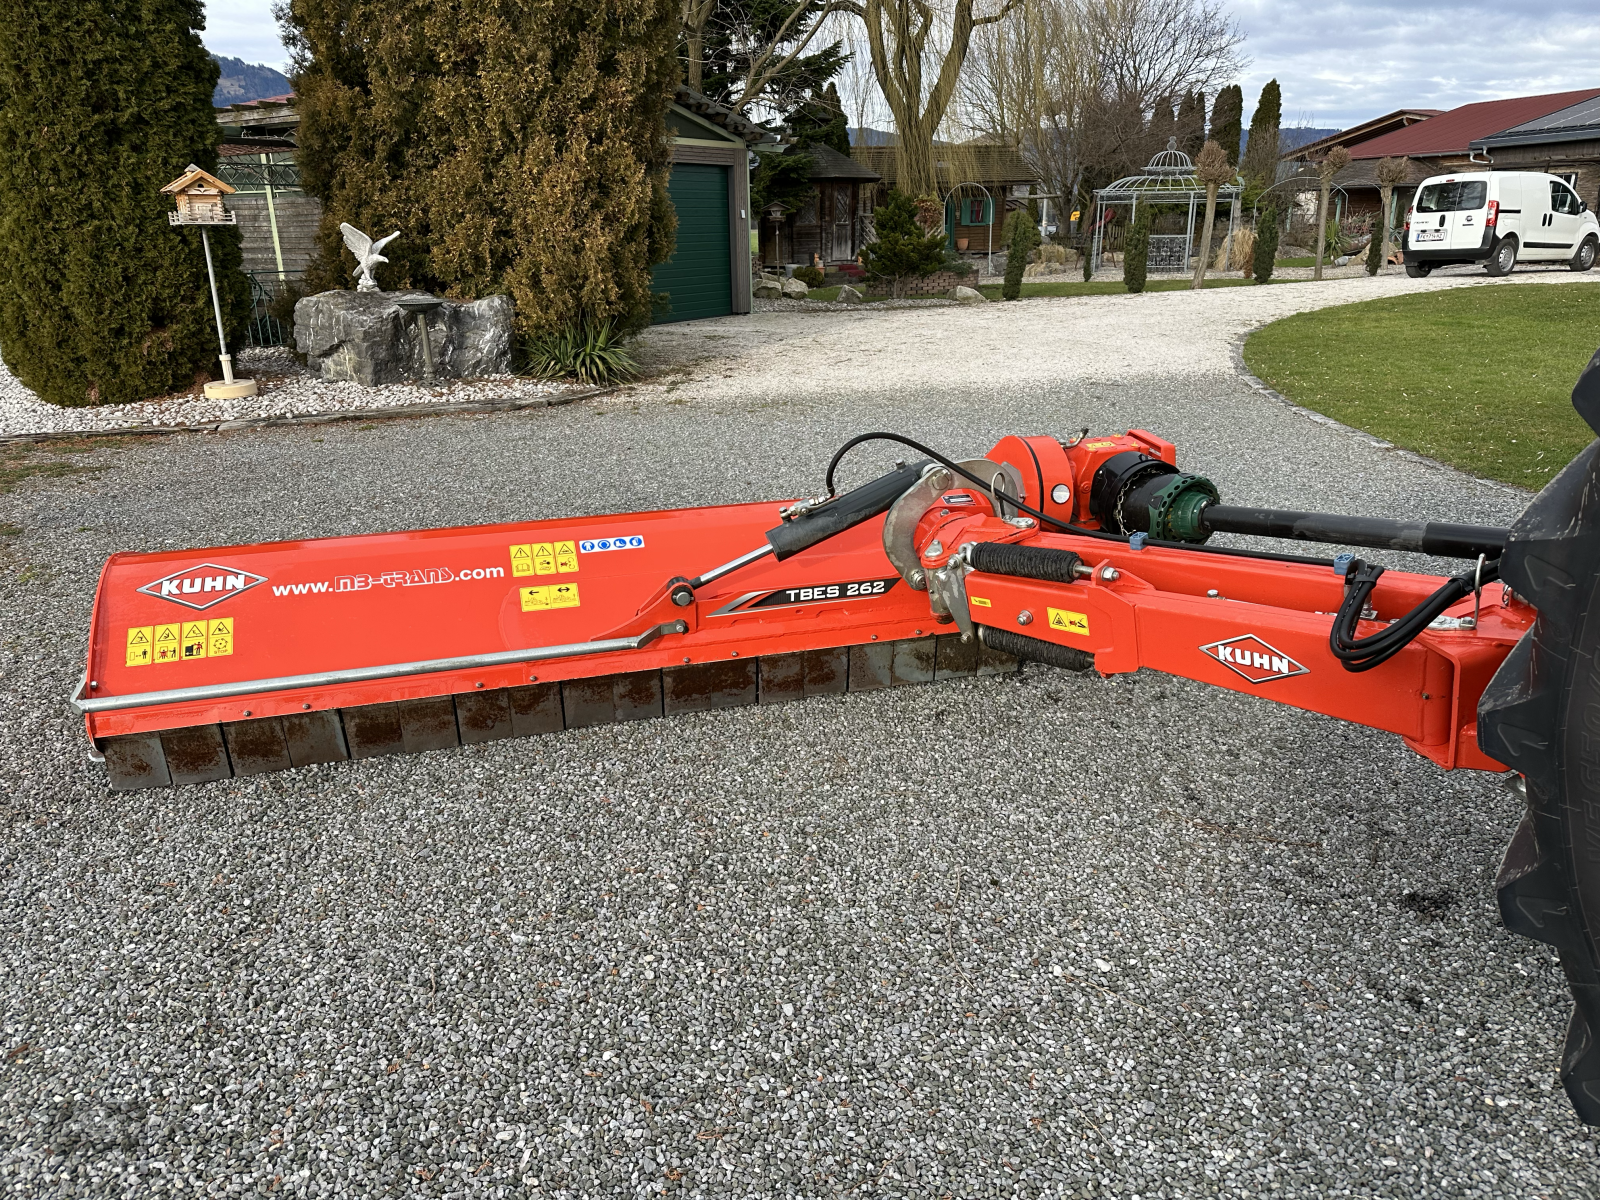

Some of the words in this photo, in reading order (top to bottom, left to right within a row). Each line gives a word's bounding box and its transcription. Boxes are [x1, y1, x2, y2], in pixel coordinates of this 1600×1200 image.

[161, 574, 245, 596] KUHN
[786, 585, 840, 602] TBES
[846, 581, 885, 596] 262
[1217, 644, 1289, 674] KUHN
